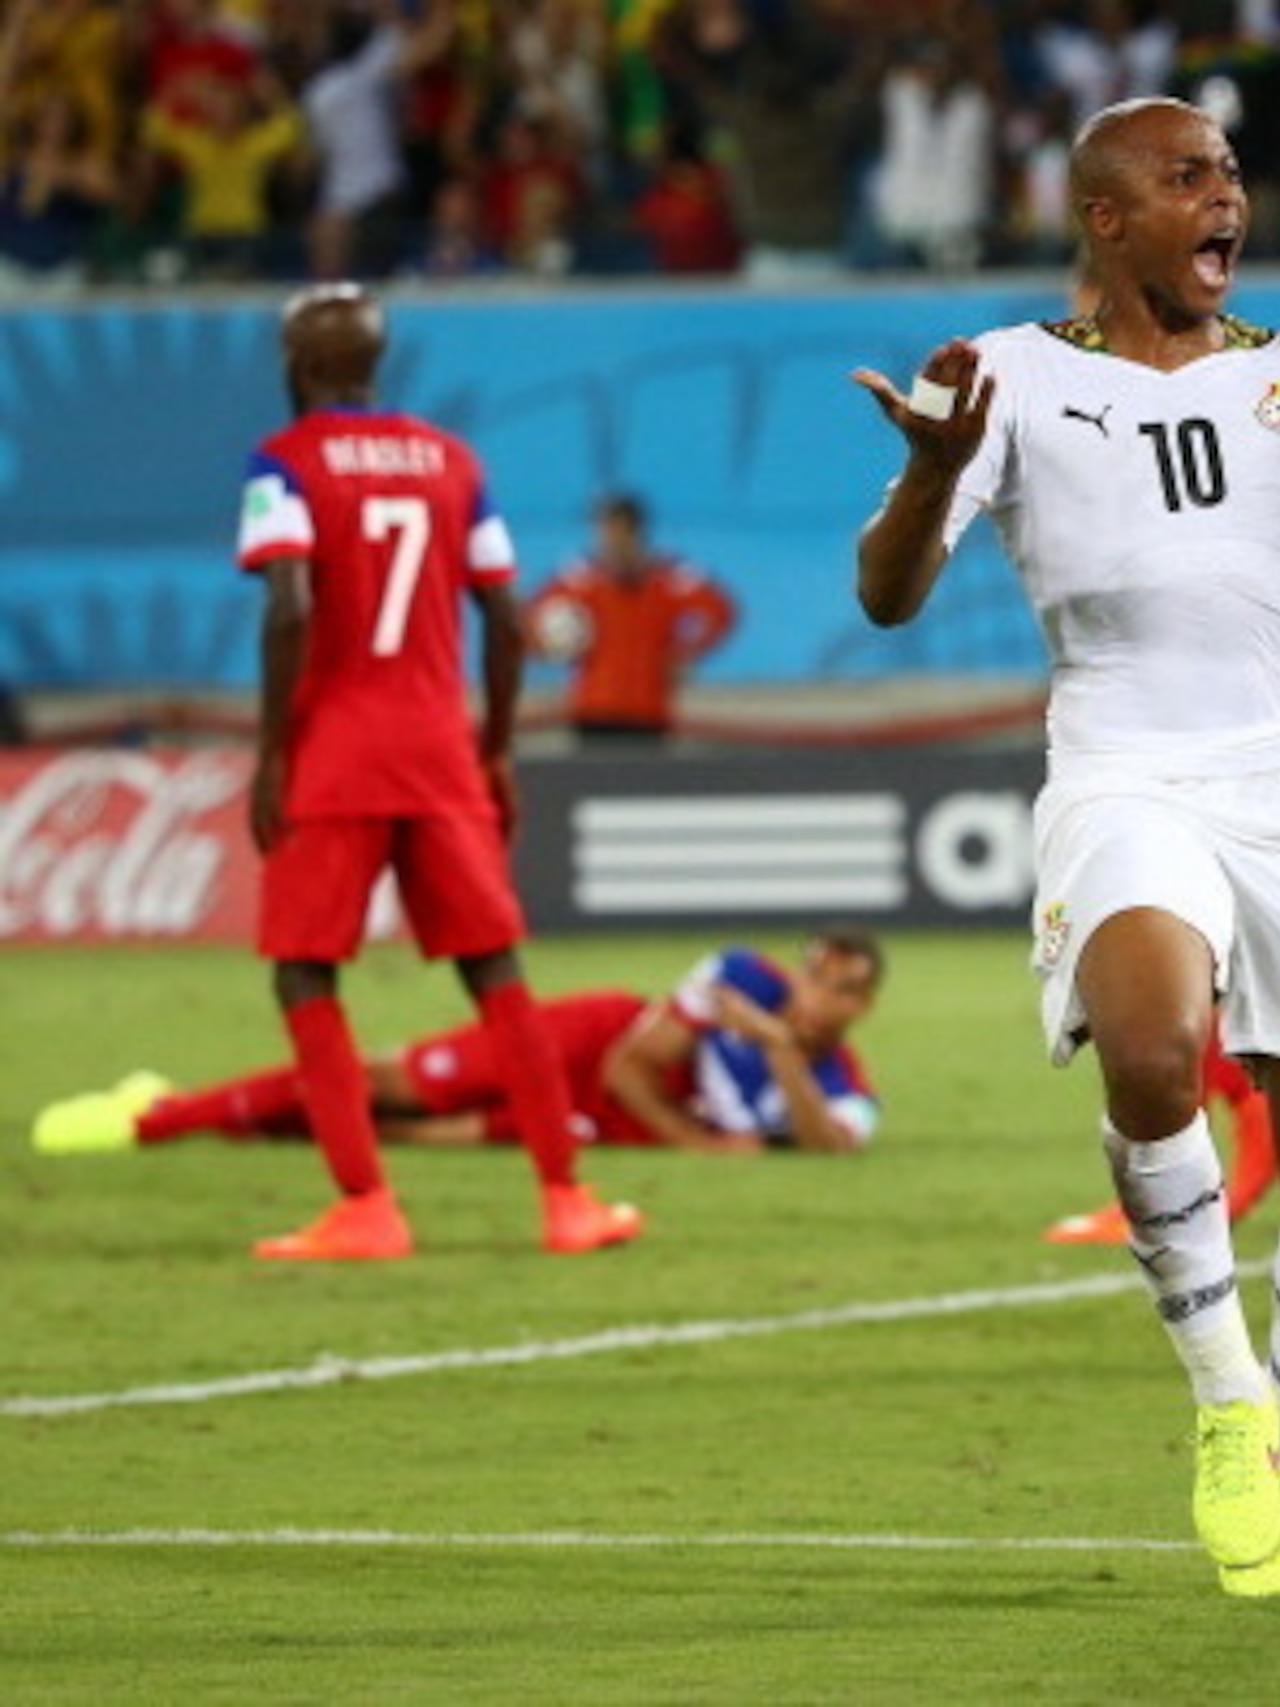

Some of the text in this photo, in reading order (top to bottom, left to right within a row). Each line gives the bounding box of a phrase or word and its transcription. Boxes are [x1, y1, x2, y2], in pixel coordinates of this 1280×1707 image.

[321, 435, 446, 477] BEASLEY
[1138, 417, 1227, 512] 10
[361, 497, 430, 657] 7
